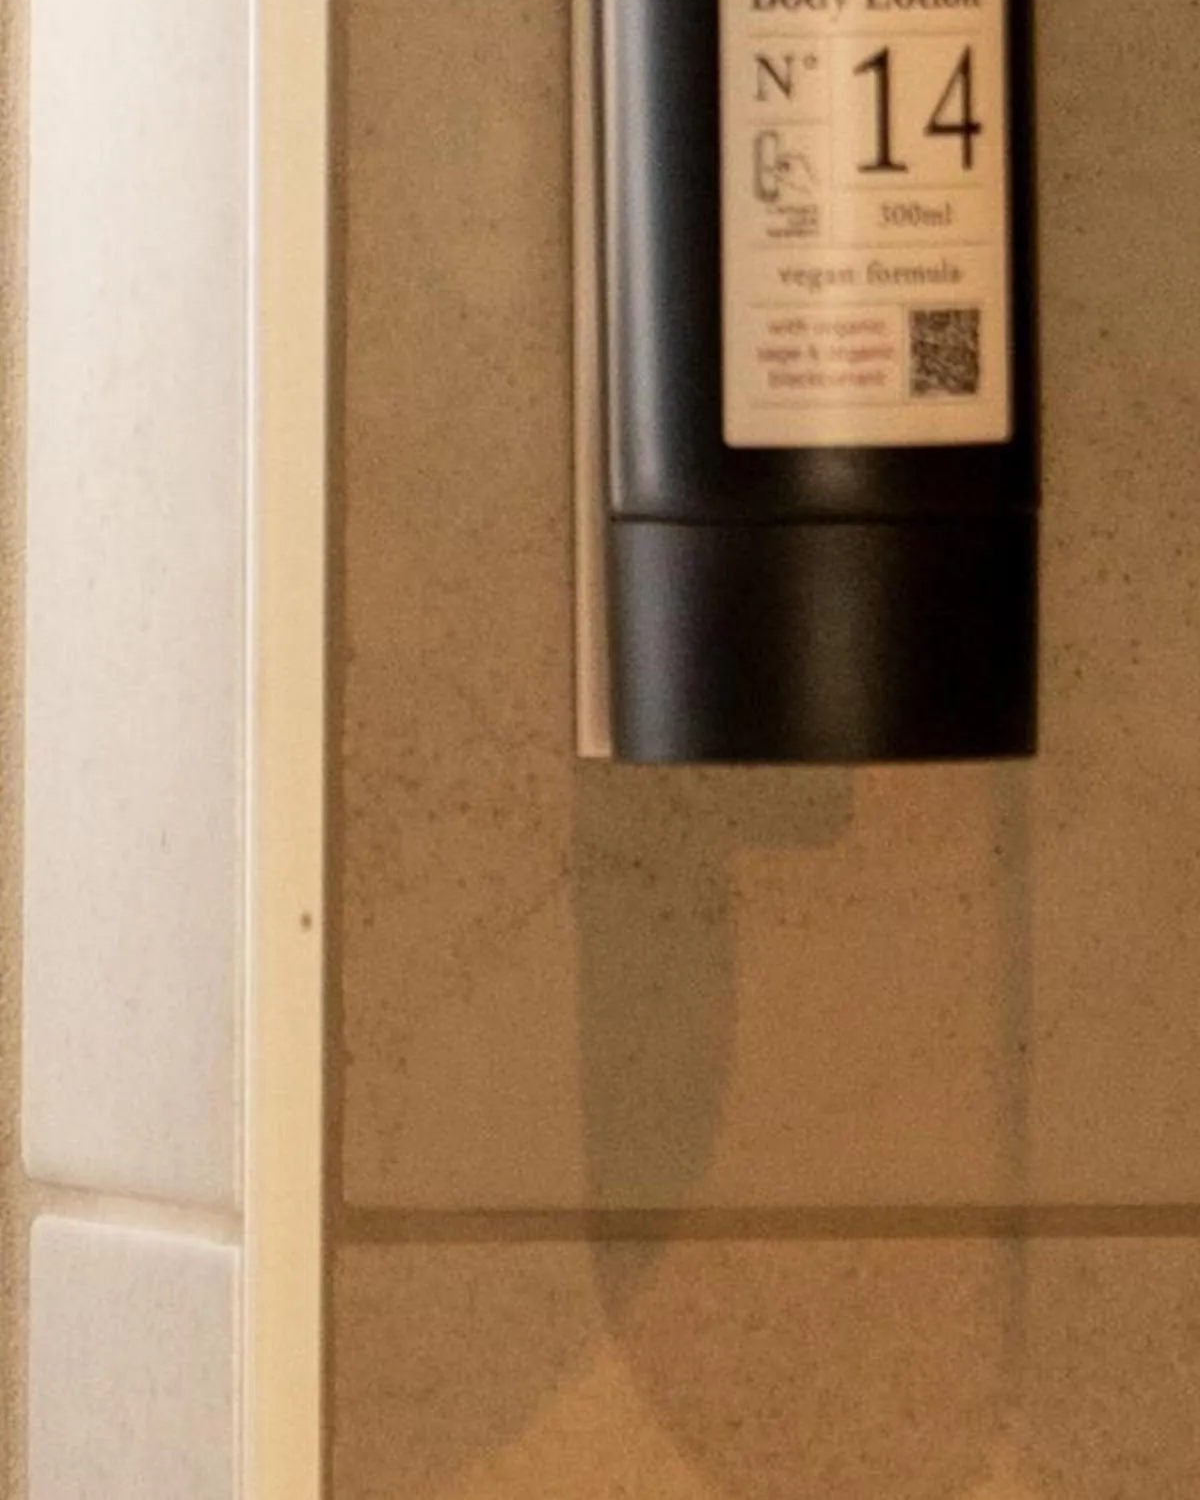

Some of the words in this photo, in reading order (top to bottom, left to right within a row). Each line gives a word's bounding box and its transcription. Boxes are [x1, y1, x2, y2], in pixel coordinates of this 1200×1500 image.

[852, 44, 983, 173] 14
[778, 267, 855, 293] vegan
[866, 260, 964, 285] formula
